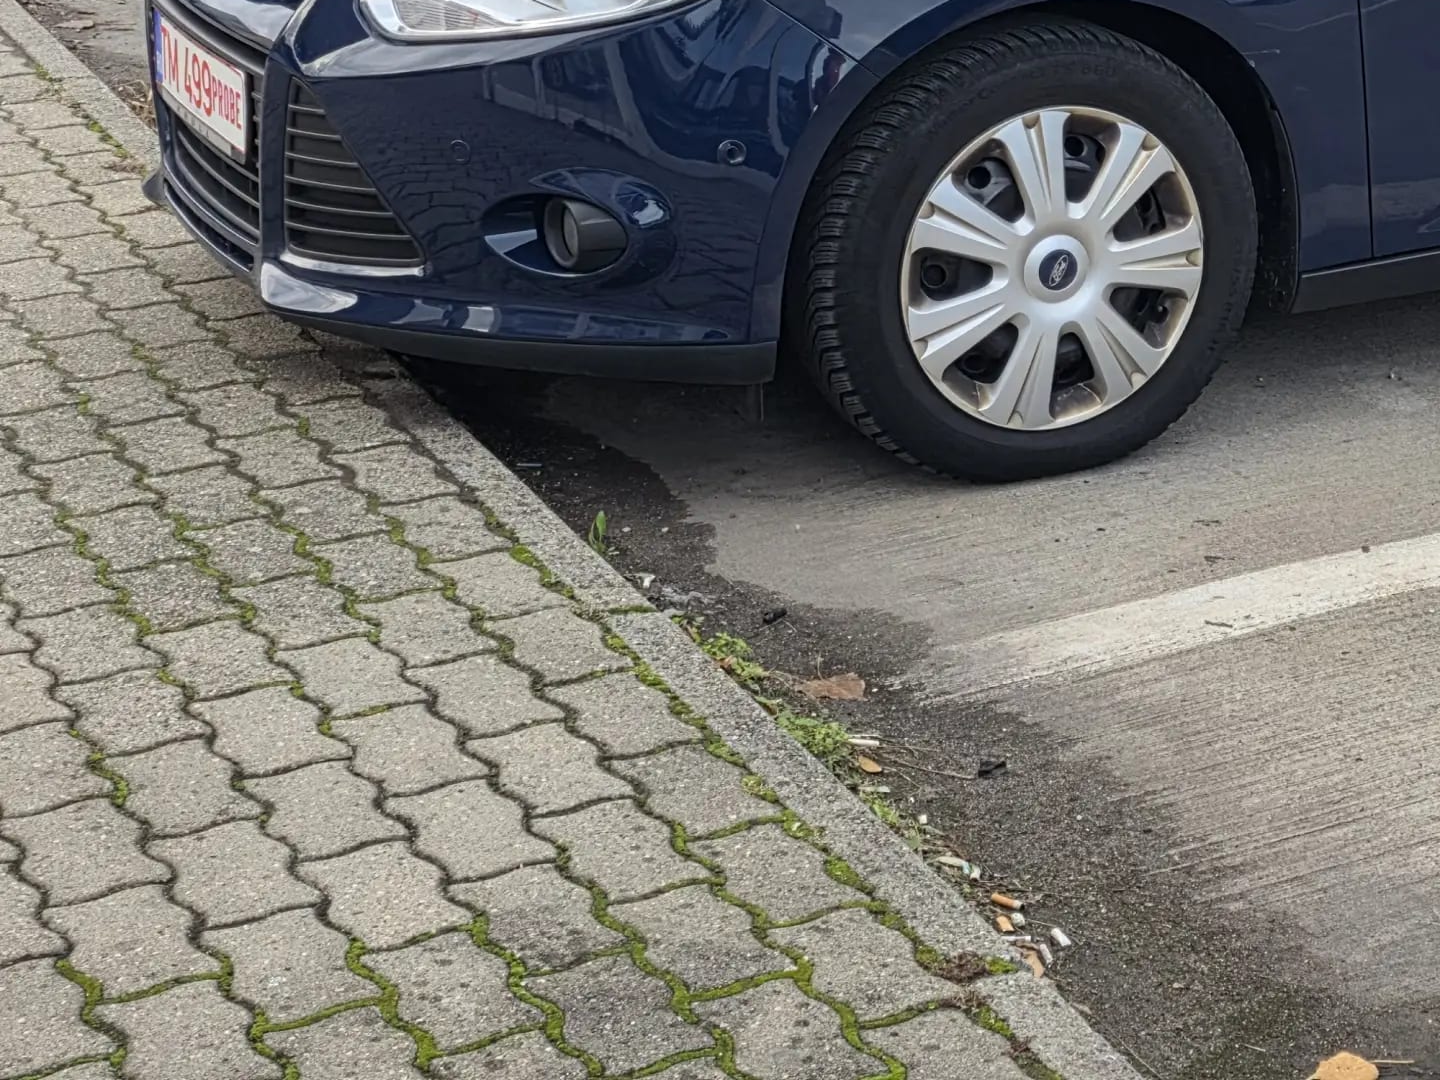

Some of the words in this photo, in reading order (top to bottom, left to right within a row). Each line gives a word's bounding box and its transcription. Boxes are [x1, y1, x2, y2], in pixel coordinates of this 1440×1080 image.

[160, 24, 180, 93] TM
[184, 46, 212, 118] 499
[211, 75, 243, 130] PROBE
